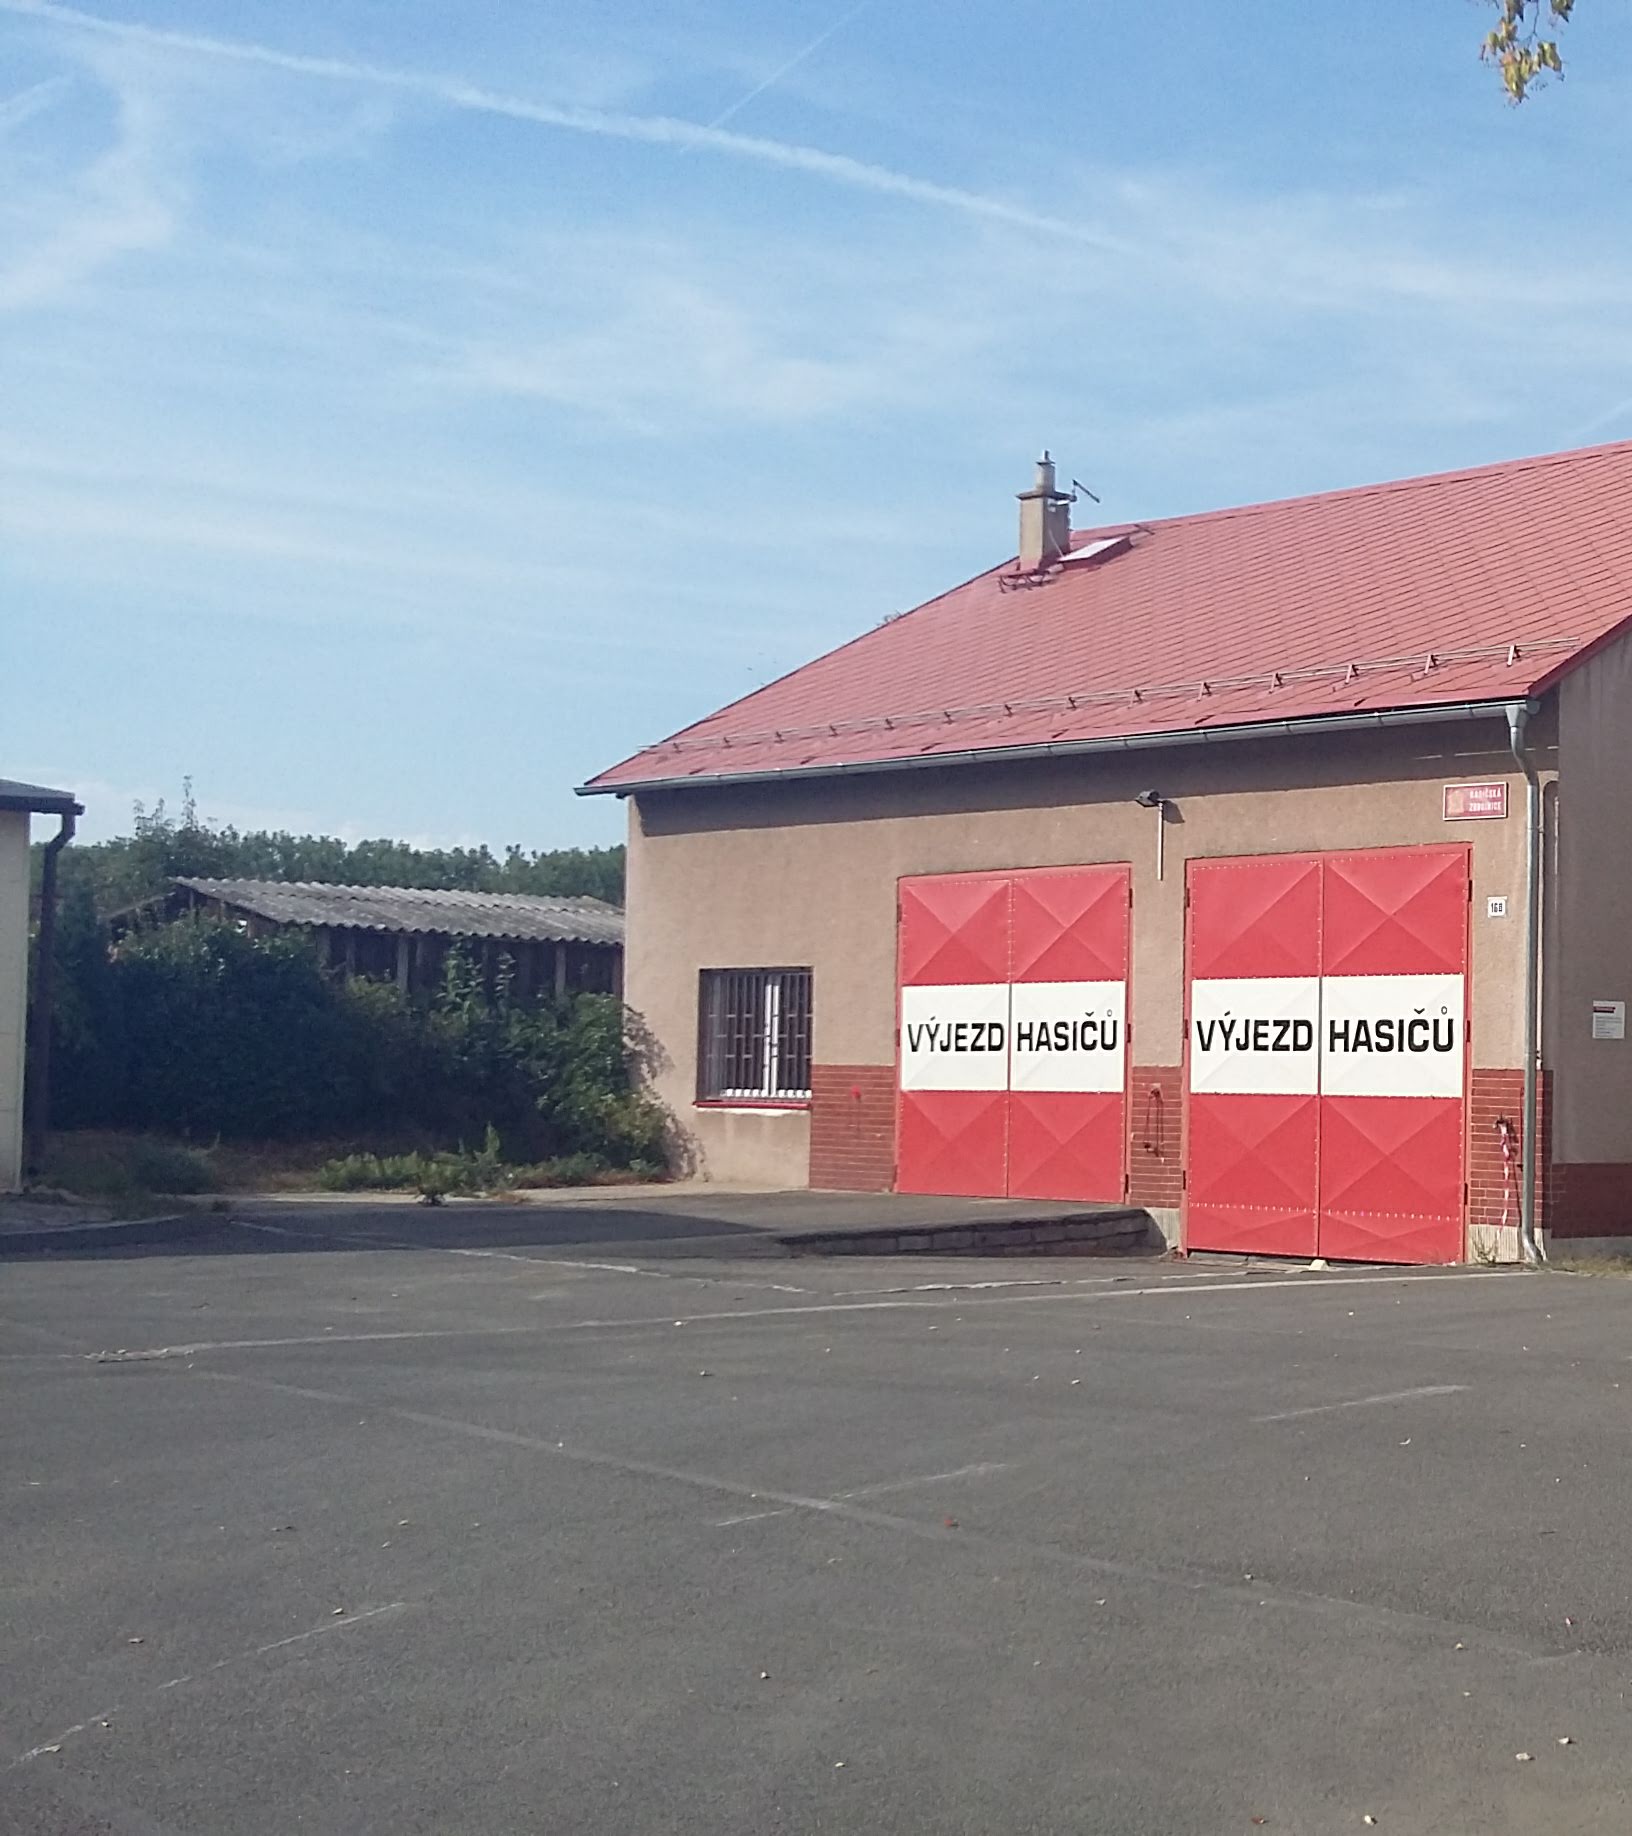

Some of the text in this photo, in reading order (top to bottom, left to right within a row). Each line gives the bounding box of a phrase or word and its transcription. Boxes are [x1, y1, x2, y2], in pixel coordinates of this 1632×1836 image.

[907, 1008, 1118, 1053] VÝJEZD HASIČŮ
[1195, 1004, 1454, 1053] VÝJEZD HASIČŮ
